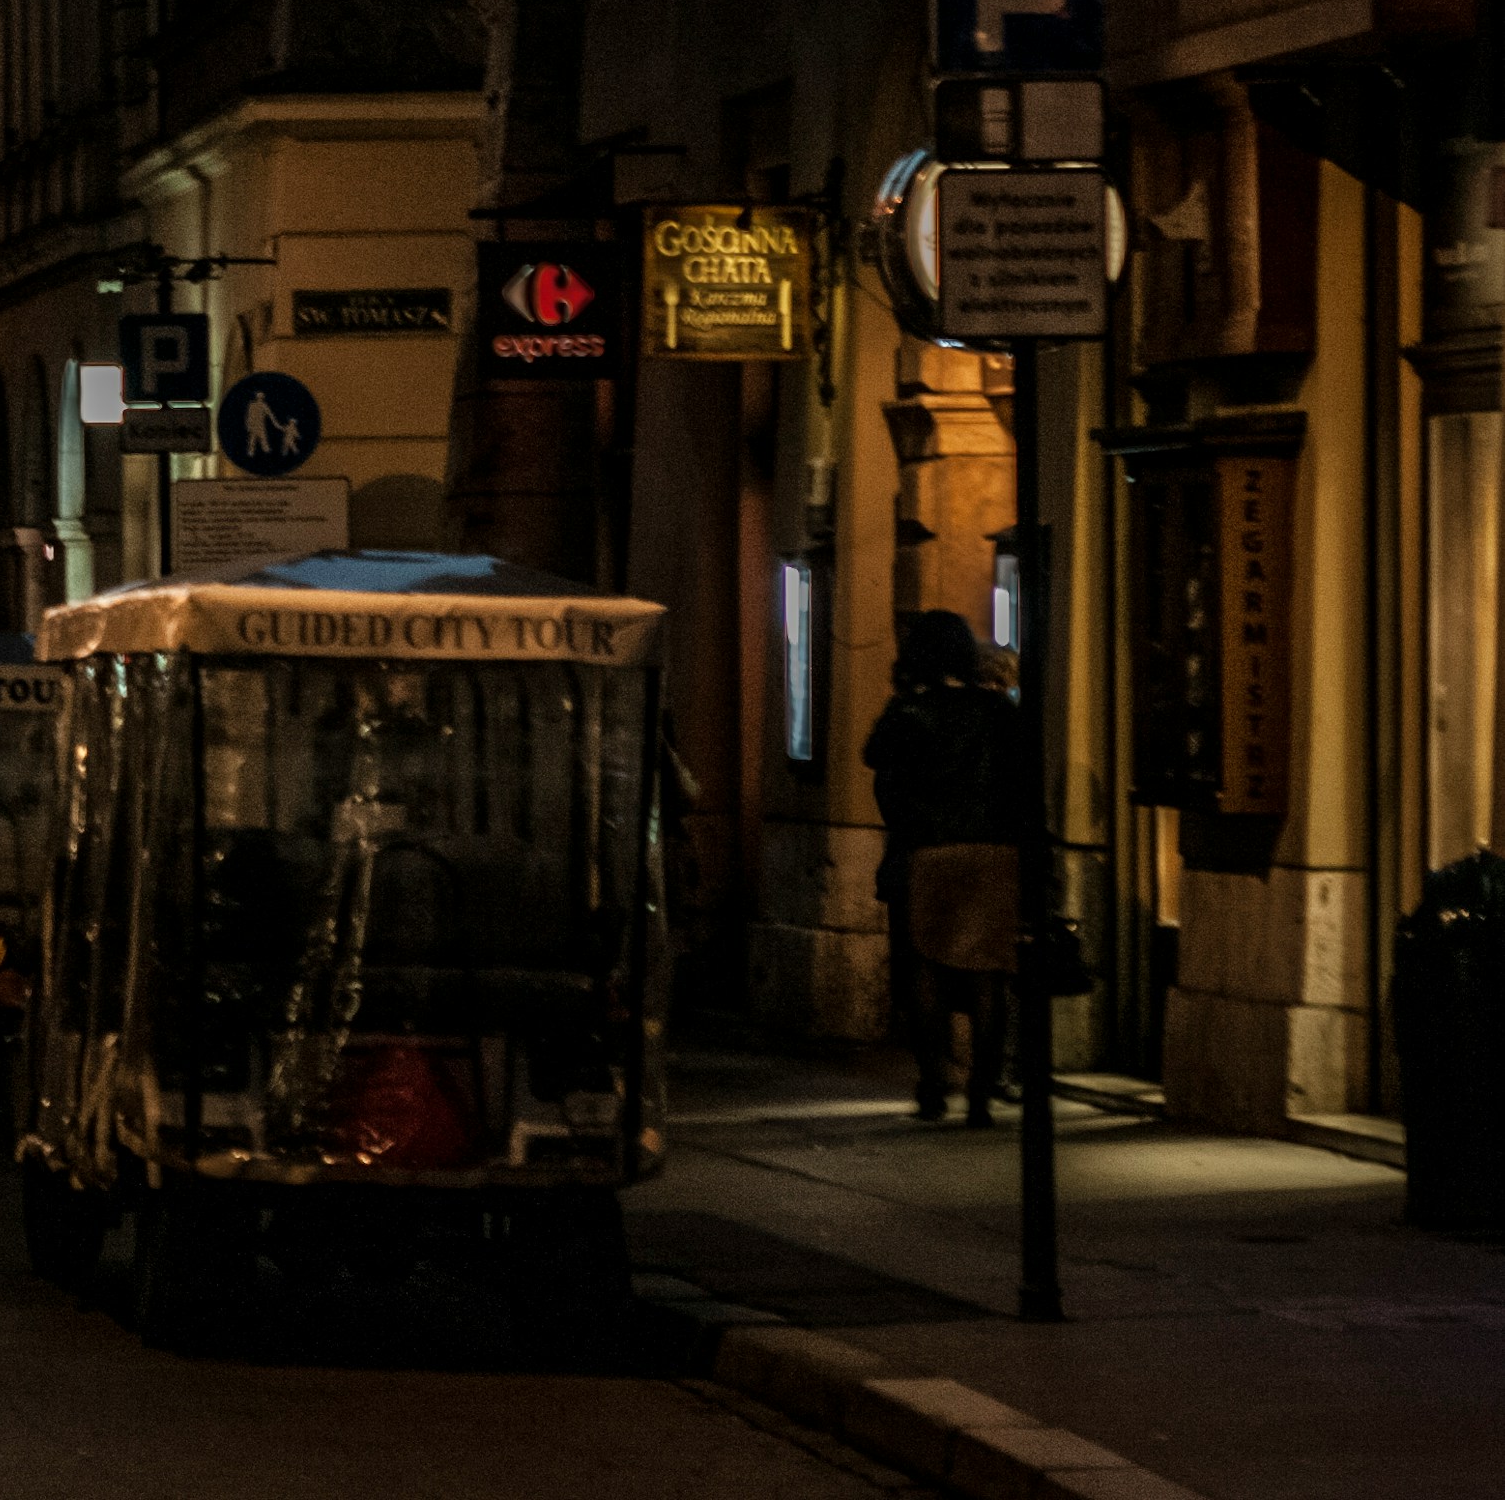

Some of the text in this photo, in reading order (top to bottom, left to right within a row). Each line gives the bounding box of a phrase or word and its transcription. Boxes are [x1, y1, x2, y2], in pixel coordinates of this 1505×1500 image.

[682, 256, 773, 284] CHATA
[139, 323, 191, 395] P
[492, 334, 606, 363] express
[237, 610, 617, 658] GUIDED CITY TOUR
[1241, 470, 1268, 799] ZEGARMISTRZ
